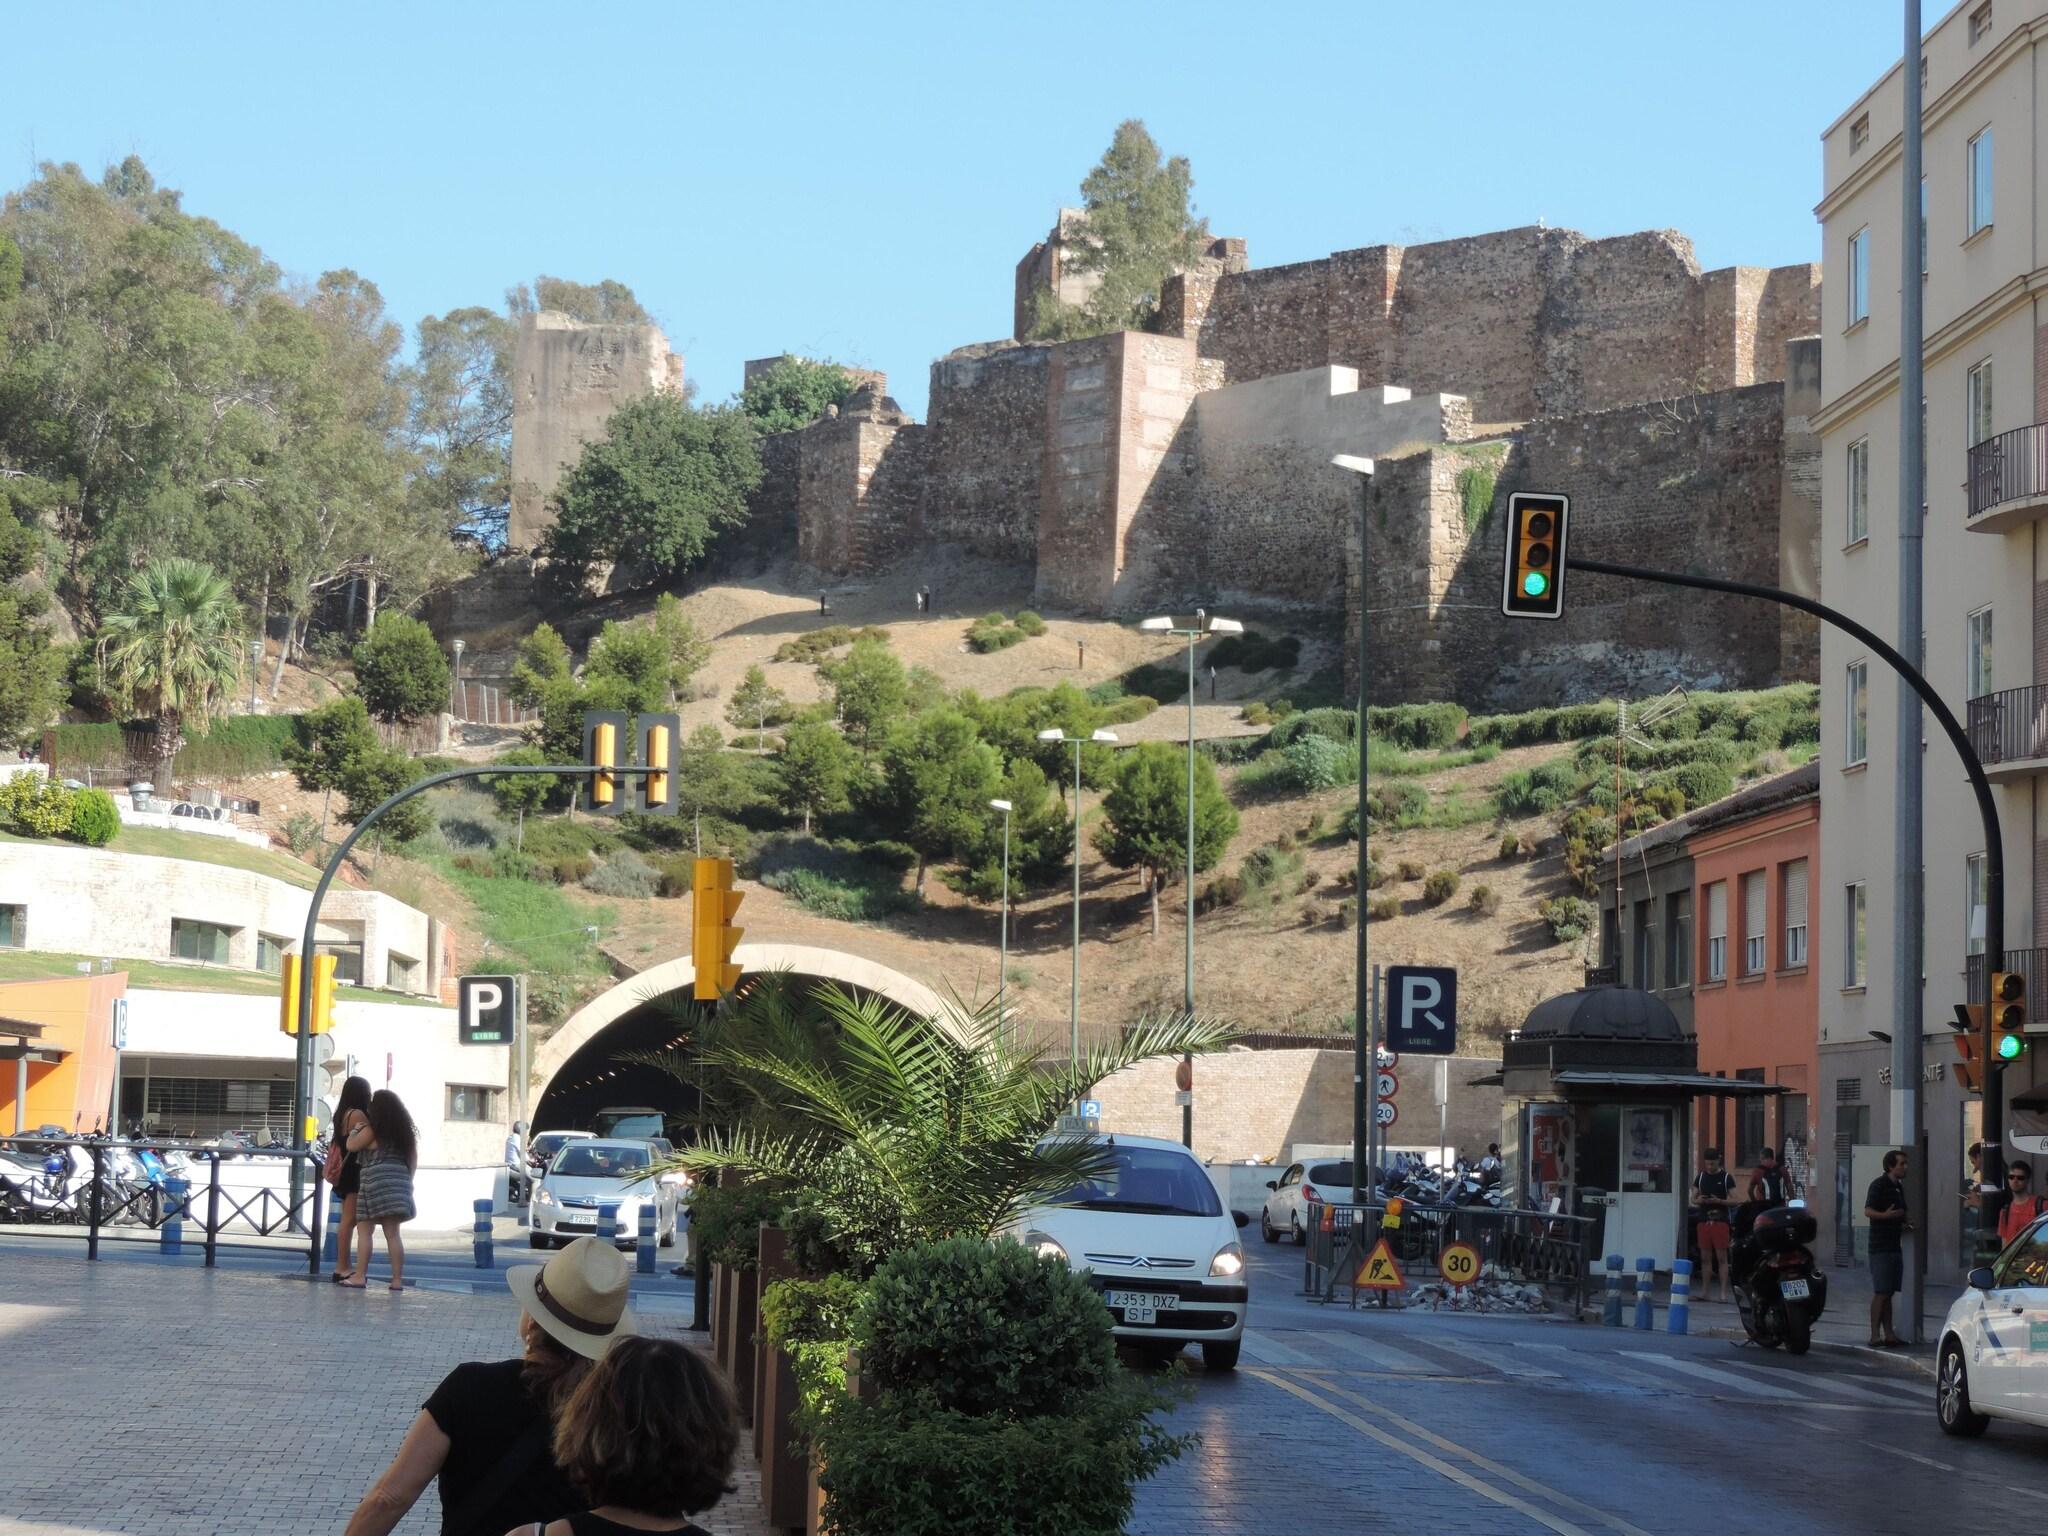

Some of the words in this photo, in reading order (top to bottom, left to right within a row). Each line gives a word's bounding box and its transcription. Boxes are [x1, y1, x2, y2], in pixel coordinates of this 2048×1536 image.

[470, 984, 502, 1026] P
[473, 1032, 501, 1040] LIBRE
[1409, 1037, 1431, 1045] LIBRE
[1377, 1109, 1392, 1119] 20
[1448, 1255, 1471, 1273] 30
[1114, 1293, 1146, 1306] 2353
[1153, 1295, 1176, 1308] DXZ
[1129, 1308, 1152, 1321] SP
